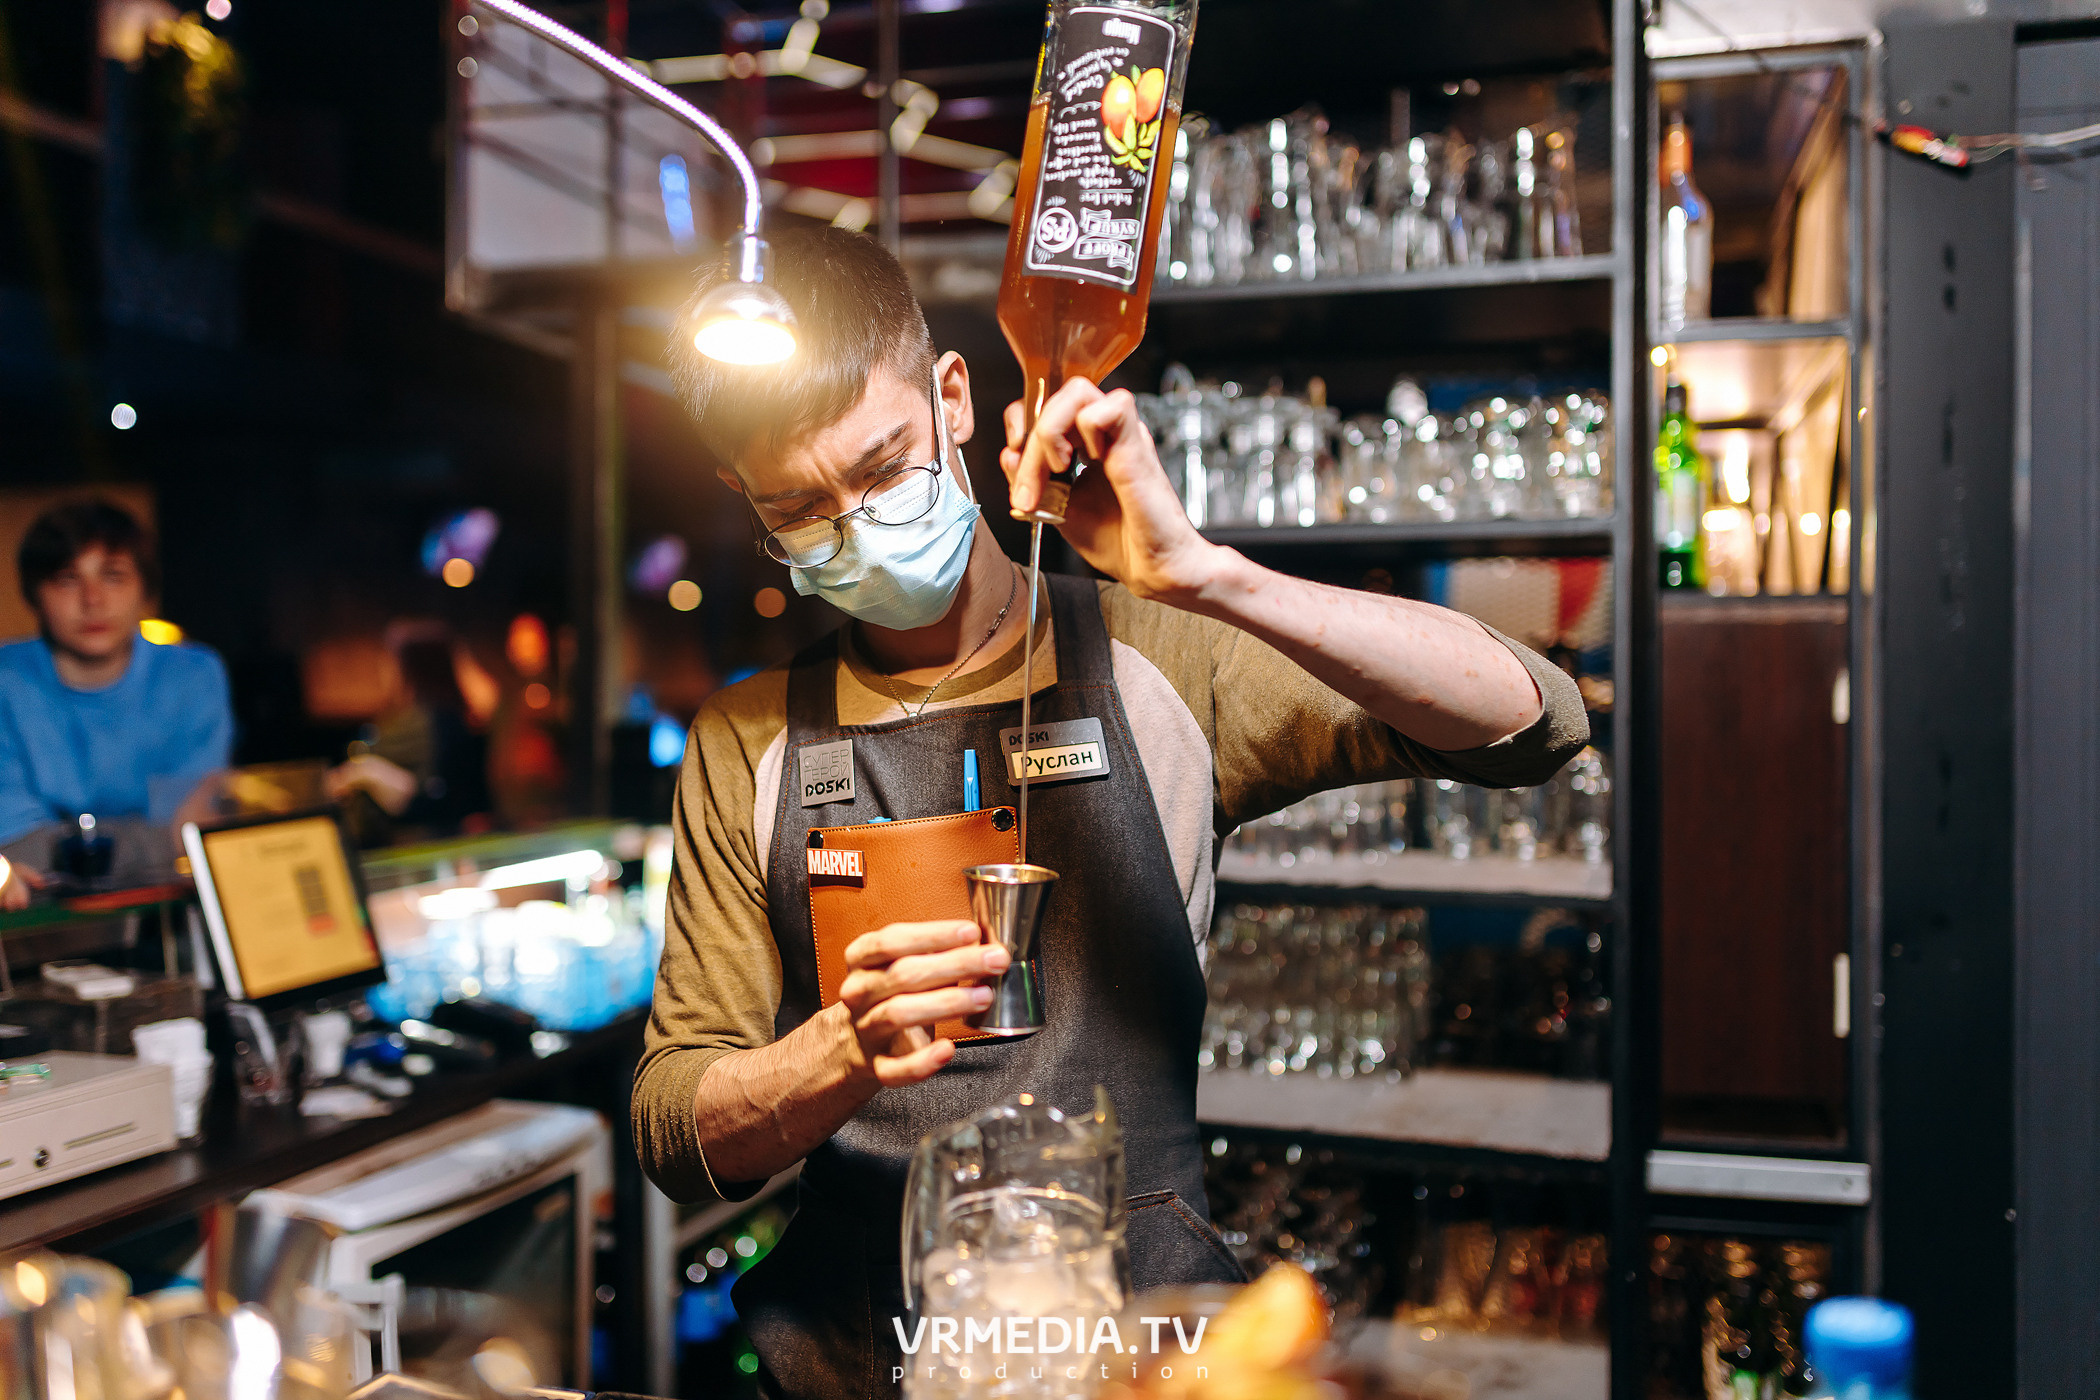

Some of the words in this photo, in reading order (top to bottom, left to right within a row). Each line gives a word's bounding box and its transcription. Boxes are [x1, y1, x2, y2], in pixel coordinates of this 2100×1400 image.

[803, 748, 850, 769] СУПЕР
[1021, 750, 1094, 775] Руслан
[803, 762, 852, 783] ГЕРОЙ
[805, 778, 851, 797] DOSKI
[808, 850, 863, 876] MARVEL
